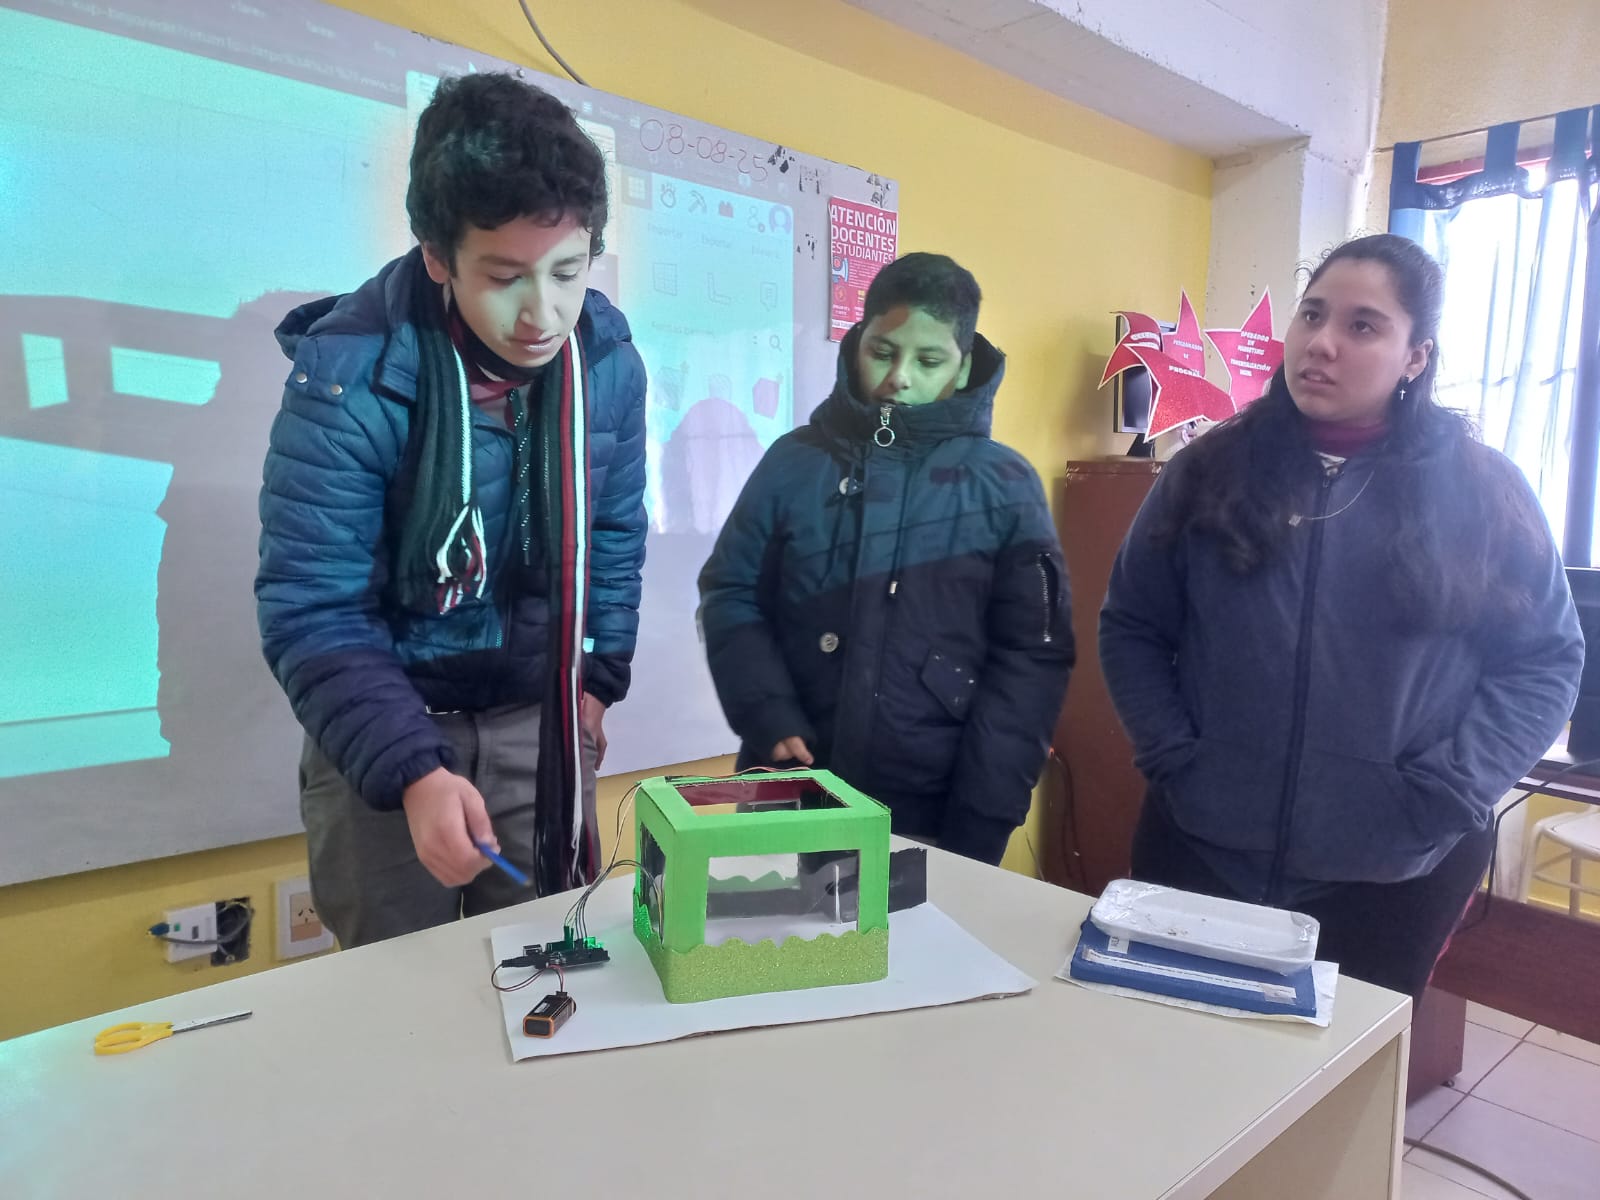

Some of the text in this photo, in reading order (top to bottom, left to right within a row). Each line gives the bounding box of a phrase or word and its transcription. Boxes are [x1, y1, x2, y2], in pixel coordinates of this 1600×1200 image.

[640, 119, 768, 182] 08-08-25
[830, 204, 896, 236] ATENCIÓN
[831, 225, 895, 252] DOCENTES
[831, 241, 893, 264] ESTUDIANTES
